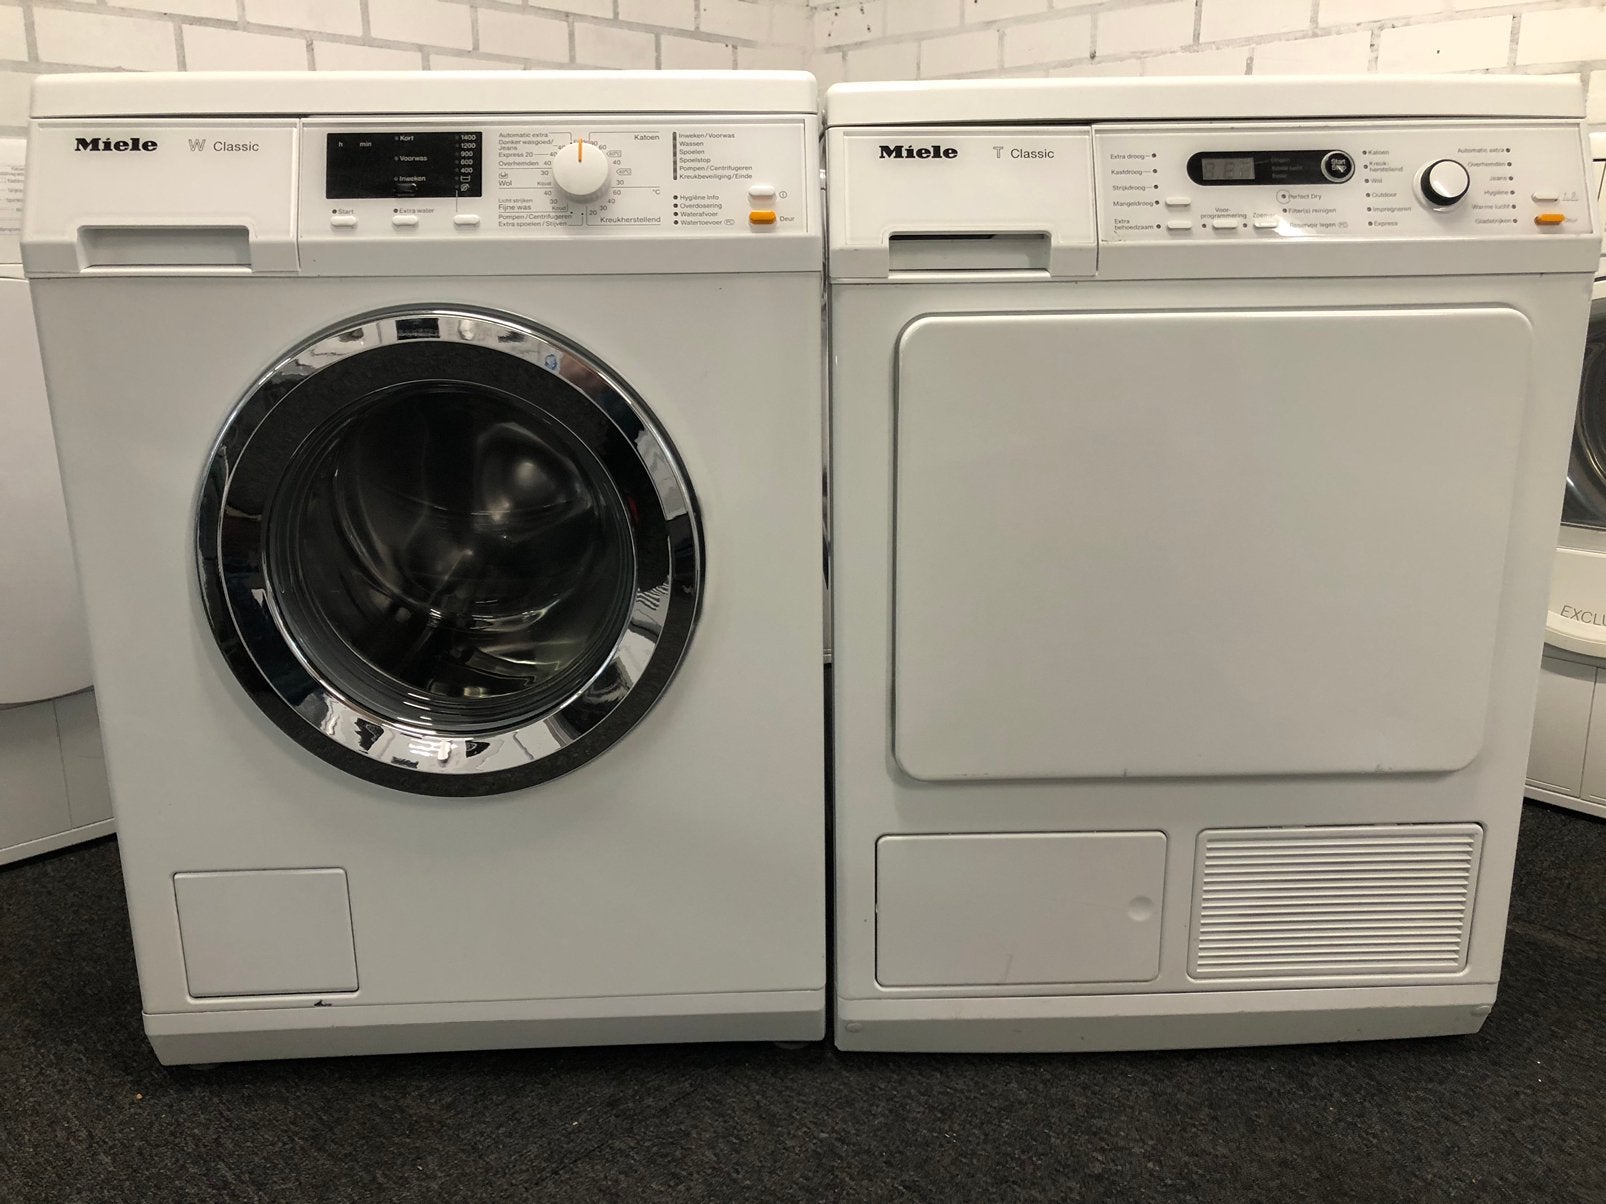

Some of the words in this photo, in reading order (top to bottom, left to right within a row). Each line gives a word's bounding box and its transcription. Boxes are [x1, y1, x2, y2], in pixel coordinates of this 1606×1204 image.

[75, 138, 158, 152] Miele
[188, 139, 206, 151] W
[213, 141, 259, 152] Classic
[879, 145, 958, 159] Miele
[993, 147, 1003, 158] T
[1011, 148, 1054, 159] Classic
